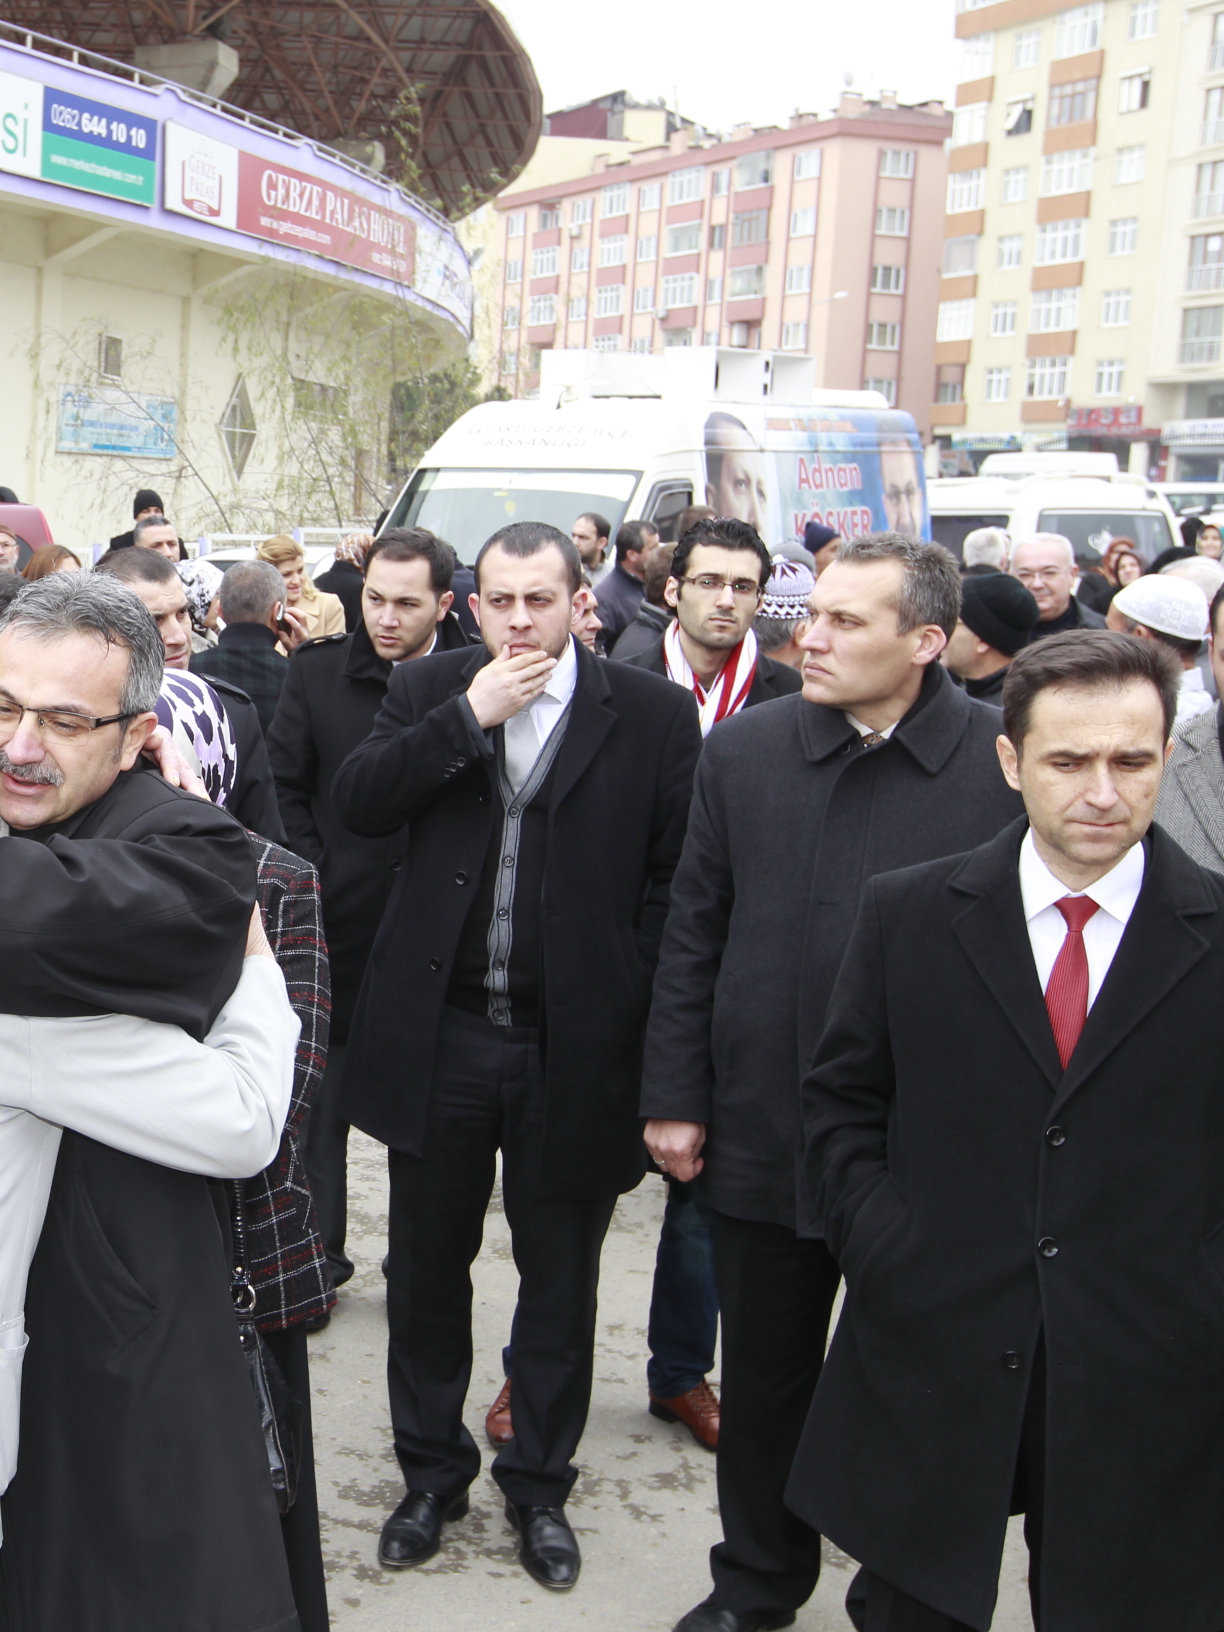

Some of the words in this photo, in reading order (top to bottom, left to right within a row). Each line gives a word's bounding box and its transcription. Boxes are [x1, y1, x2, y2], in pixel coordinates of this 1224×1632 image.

[50, 103, 79, 130] 0262
[81, 112, 108, 138] 644
[110, 121, 127, 143] 10
[130, 127, 147, 149] 10
[187, 154, 217, 180] GEBZE
[261, 169, 323, 220] GEBZE
[324, 190, 369, 239] PALAS
[369, 209, 406, 255] HOTEL
[798, 456, 862, 491] Adnan
